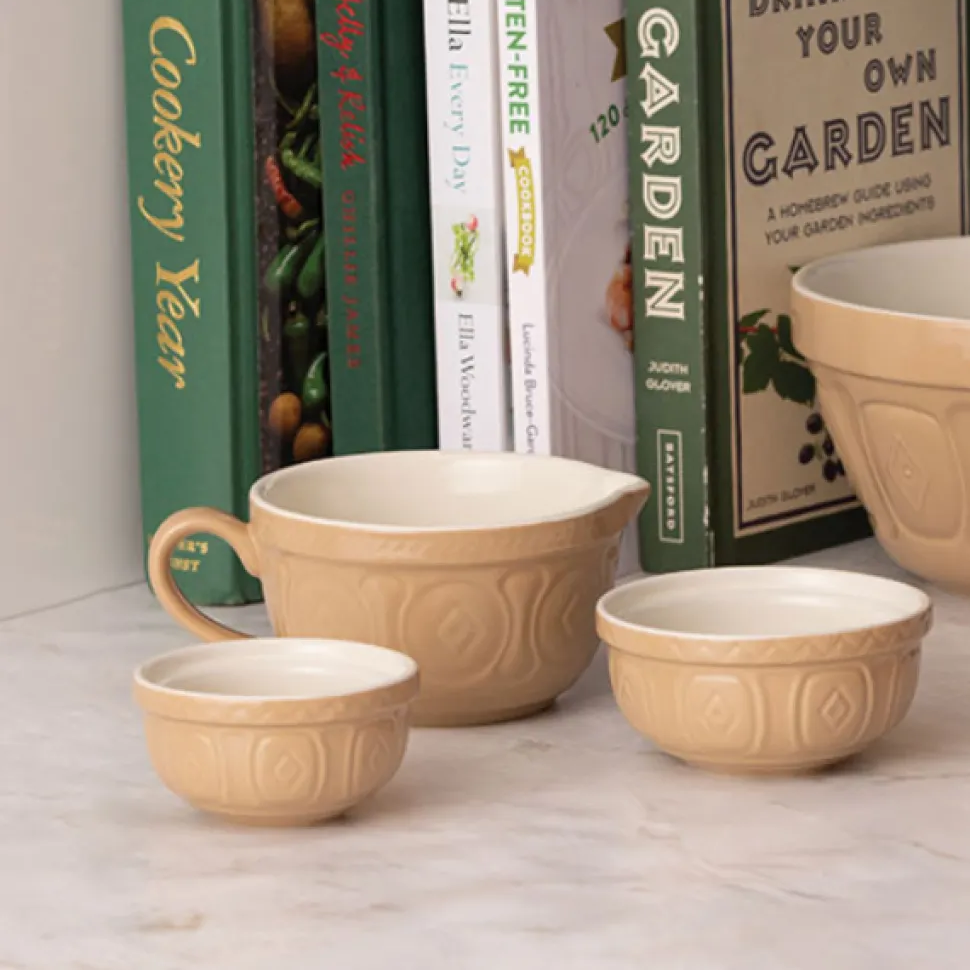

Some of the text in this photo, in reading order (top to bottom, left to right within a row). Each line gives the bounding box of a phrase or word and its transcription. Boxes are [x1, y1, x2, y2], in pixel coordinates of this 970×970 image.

[795, 11, 884, 59] YOUR
[443, 63, 469, 137] Every
[863, 48, 938, 94] OWN
[136, 15, 202, 242] Cookery
[337, 89, 367, 172] Relish
[589, 103, 620, 144] 120
[742, 95, 951, 186] GARDEN
[445, 145, 471, 195] Day
[637, 7, 686, 321] GARDEN
[517, 164, 533, 258] COOKBOOK
[764, 195, 937, 246] YOUR GARDEN INGREDIENTS
[766, 206, 777, 222] A
[853, 181, 892, 205] GUIDE
[895, 172, 933, 195] USING
[155, 258, 201, 390] Year
[458, 313, 478, 450] Ella Woodwar
[645, 377, 692, 393] GLOVER
[648, 360, 690, 375] JUDITH
